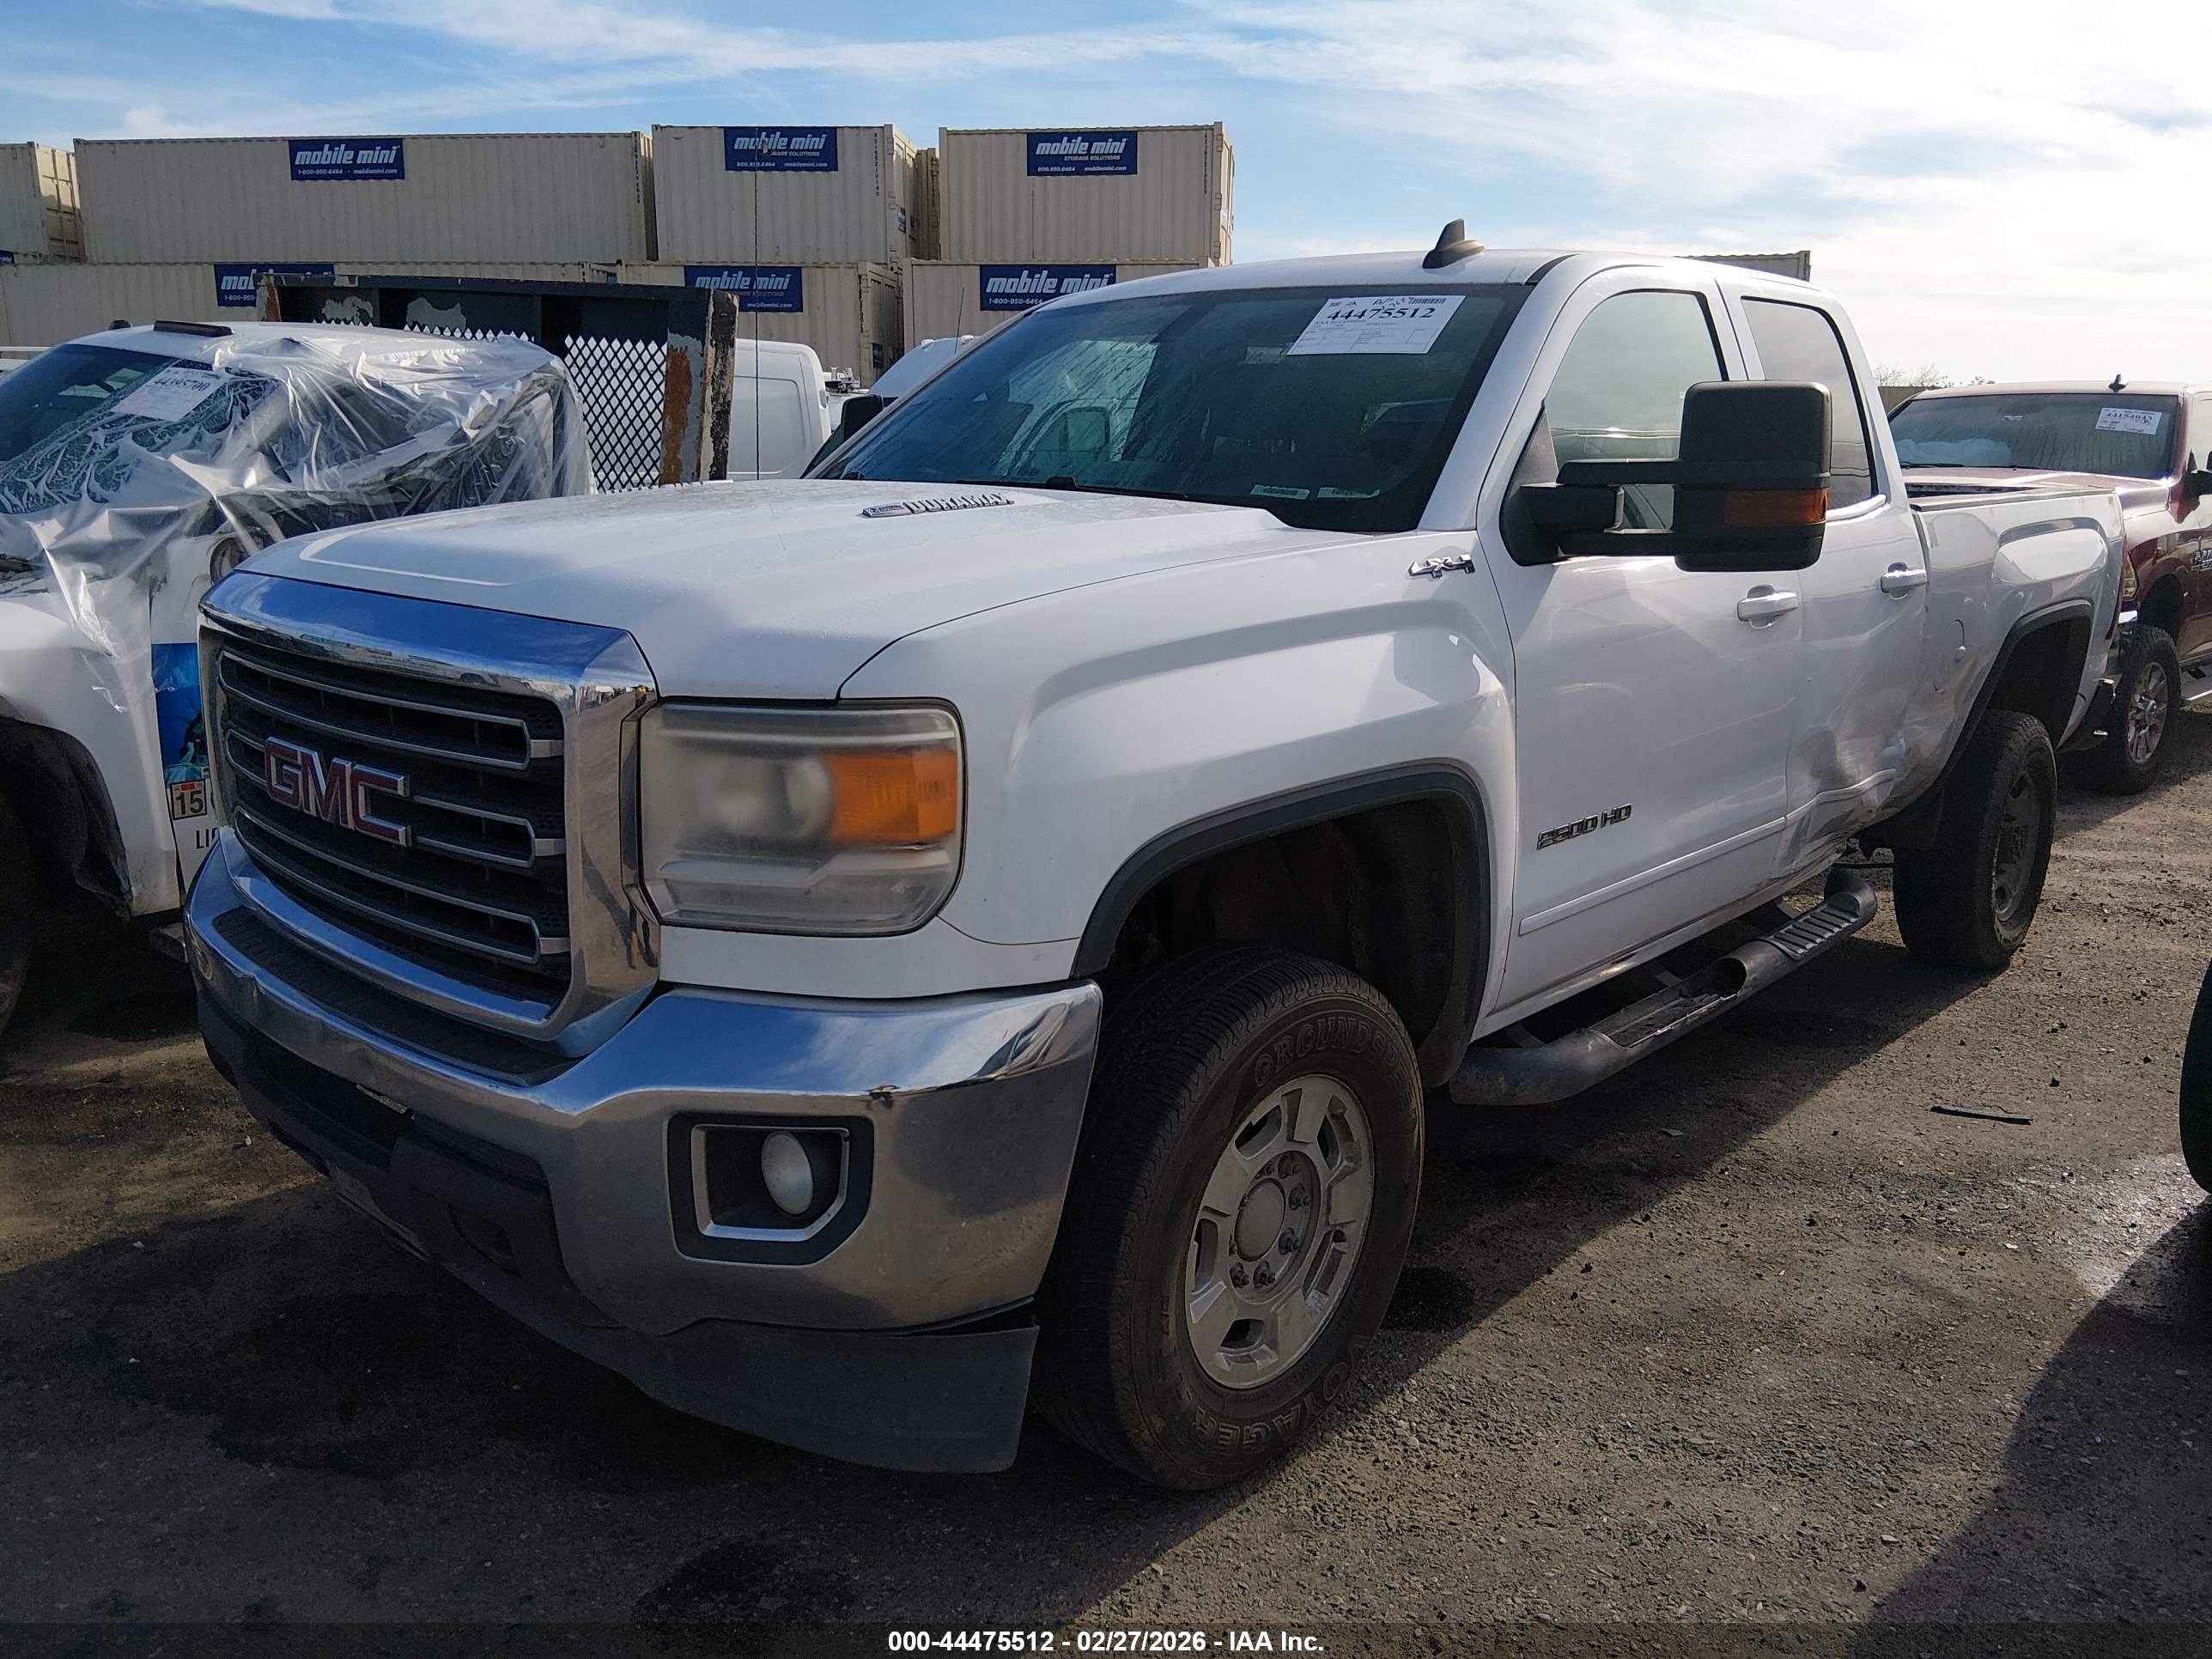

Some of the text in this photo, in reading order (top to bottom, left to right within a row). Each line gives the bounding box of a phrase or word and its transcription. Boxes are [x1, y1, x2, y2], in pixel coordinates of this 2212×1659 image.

[733, 131, 828, 149] mobile mini
[1036, 137, 1127, 155] mobile mini
[295, 143, 398, 165] mobile mini
[695, 270, 791, 289] mobile mini
[986, 270, 1109, 294] mobile mini
[1327, 307, 1436, 320] 44475512
[175, 789, 204, 816] 15
[264, 736, 412, 848] GMC
[1536, 803, 1632, 851] 2500 HD
